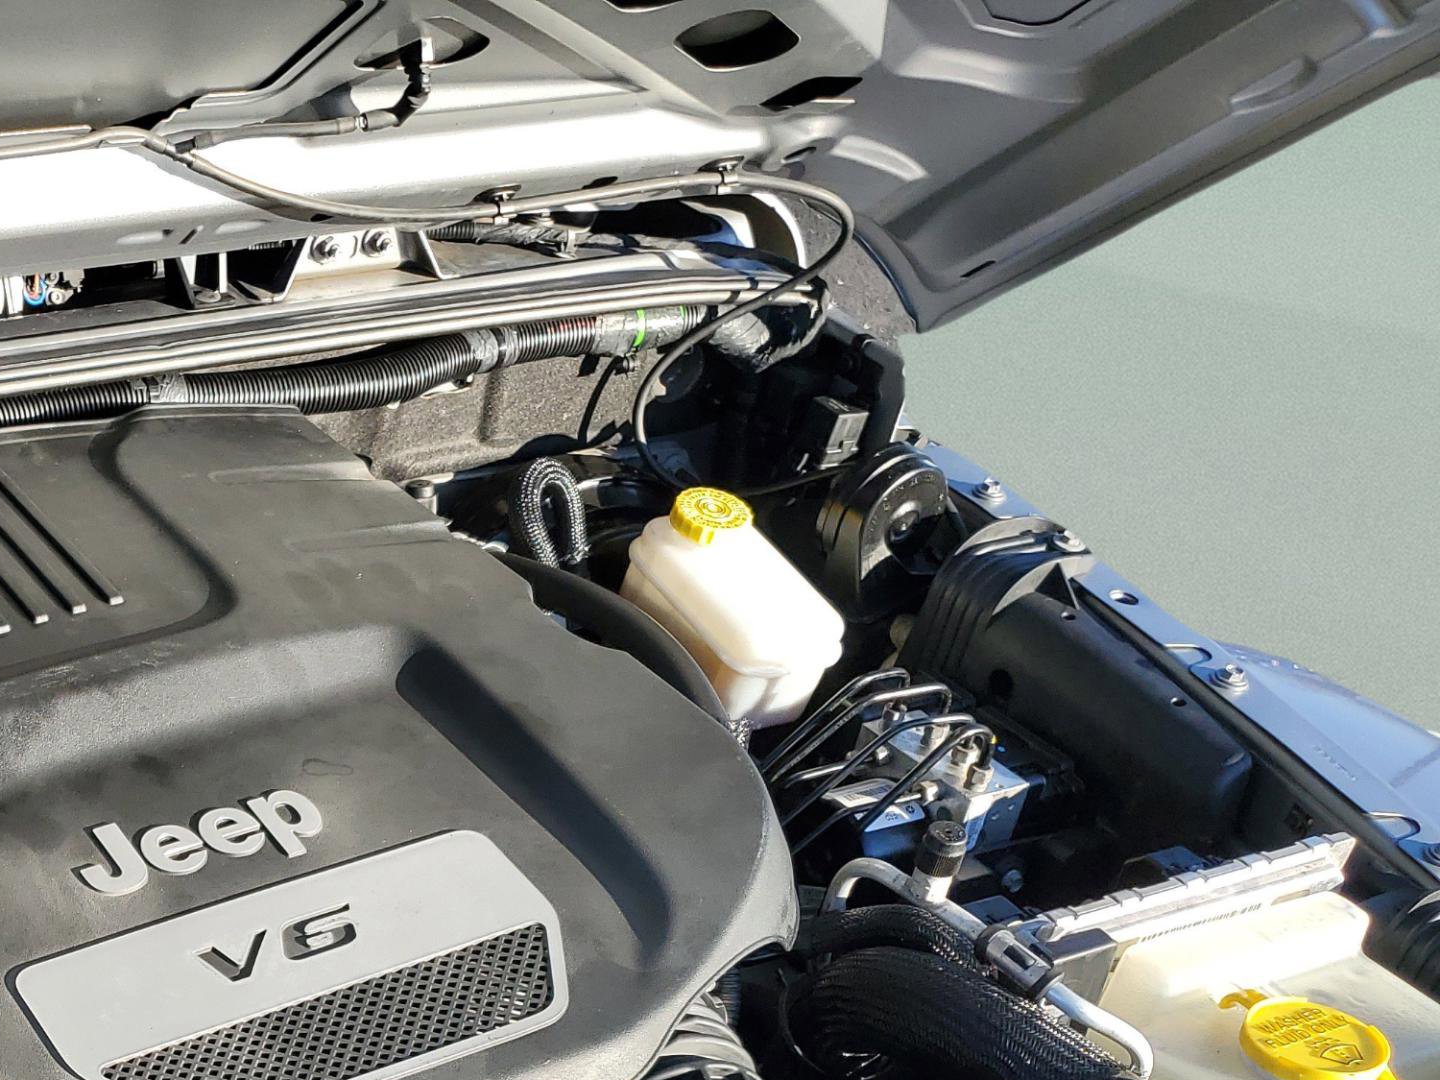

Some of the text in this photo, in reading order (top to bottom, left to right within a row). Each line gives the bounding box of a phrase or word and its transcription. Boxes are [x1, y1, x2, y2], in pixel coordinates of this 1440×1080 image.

[74, 789, 323, 896] Jeep
[193, 902, 357, 982] V6
[1258, 1007, 1327, 1034] WASHER
[1264, 1014, 1350, 1048] FLUID ONLY
